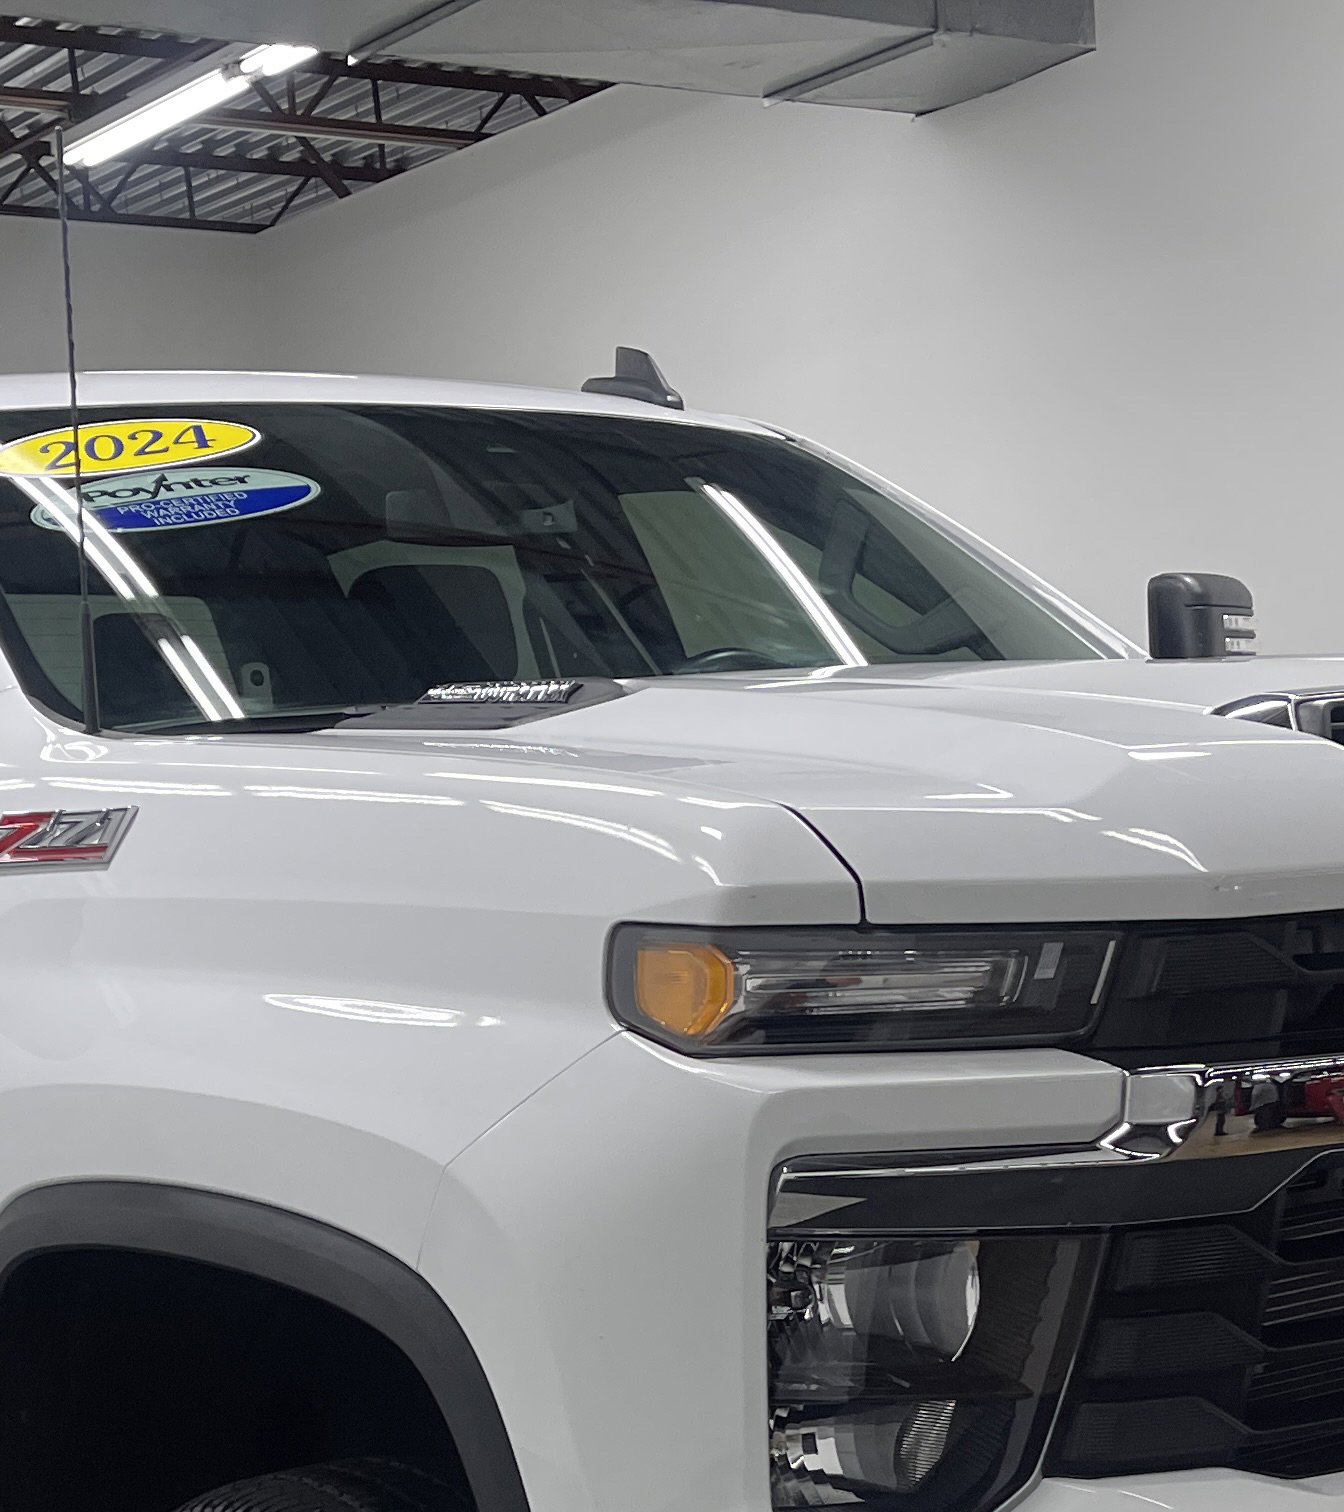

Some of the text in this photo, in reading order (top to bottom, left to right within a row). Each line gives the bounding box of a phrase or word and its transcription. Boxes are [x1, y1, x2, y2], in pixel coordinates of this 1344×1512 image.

[39, 424, 217, 470] 2024
[81, 473, 250, 503] Poynter
[116, 491, 248, 515] PRO-CERTIFIED
[140, 500, 237, 519] WARRANTY
[154, 507, 240, 526] INCLUDED
